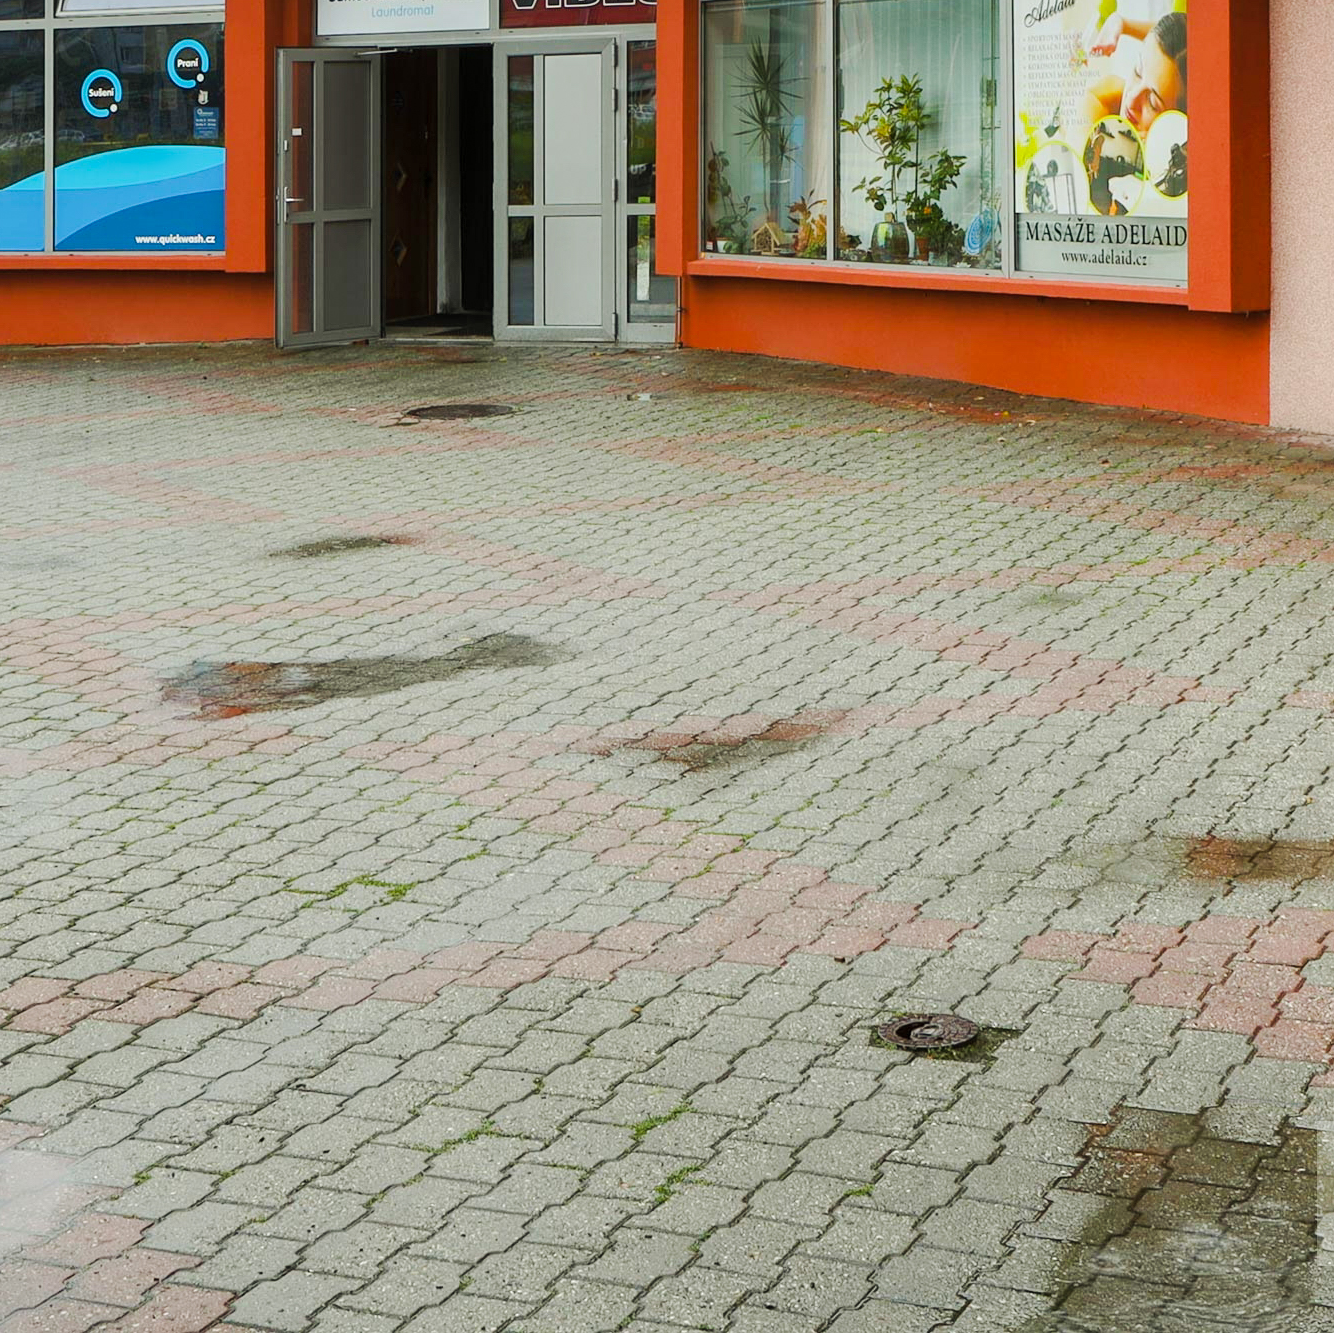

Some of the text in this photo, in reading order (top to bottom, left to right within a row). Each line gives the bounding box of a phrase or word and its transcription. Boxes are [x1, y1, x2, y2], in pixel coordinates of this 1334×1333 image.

[371, 4, 435, 18] Laundromat
[176, 57, 199, 68] Praní
[88, 86, 115, 98] Sušení
[1025, 217, 1187, 247] MASÁŽE ADELAID
[134, 233, 216, 246] www.quickwash.cz
[1061, 249, 1148, 267] www.adelaid.cz
